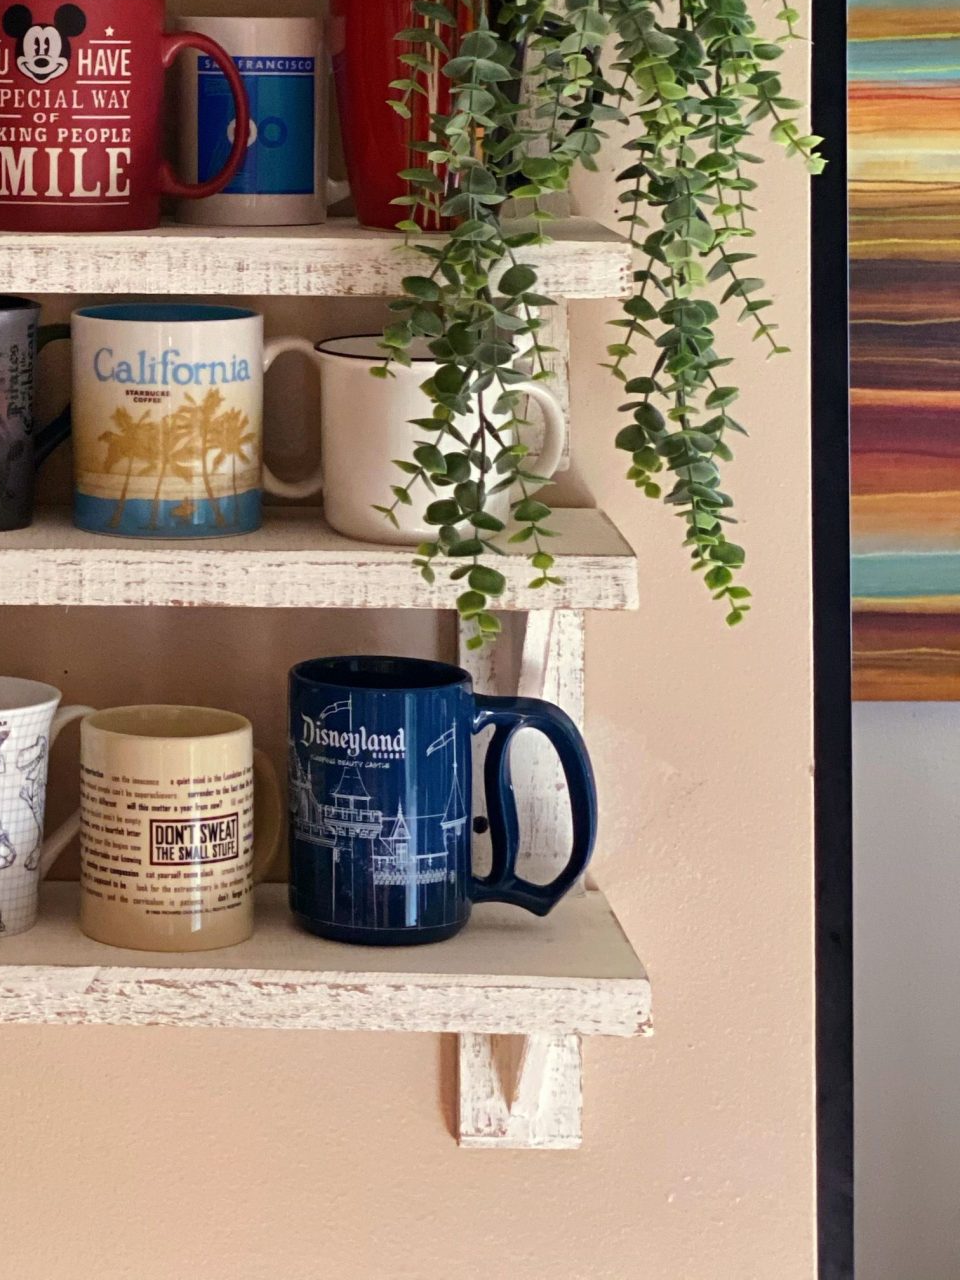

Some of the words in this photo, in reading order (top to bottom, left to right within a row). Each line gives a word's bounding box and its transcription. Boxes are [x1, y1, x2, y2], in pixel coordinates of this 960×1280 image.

[77, 48, 132, 76] HAVE
[238, 59, 313, 70] FRANCISCO
[91, 89, 131, 109] WAY
[33, 112, 60, 124] OF
[57, 128, 131, 143] PEOPLE
[93, 347, 251, 385] California
[125, 389, 171, 397] STARBUCKS
[300, 711, 407, 756] Disneyland
[372, 752, 407, 760] RESORT
[155, 823, 196, 846] DON'T
[199, 818, 237, 845] SWEAT
[155, 846, 175, 861] THE
[178, 845, 209, 861] SMALL
